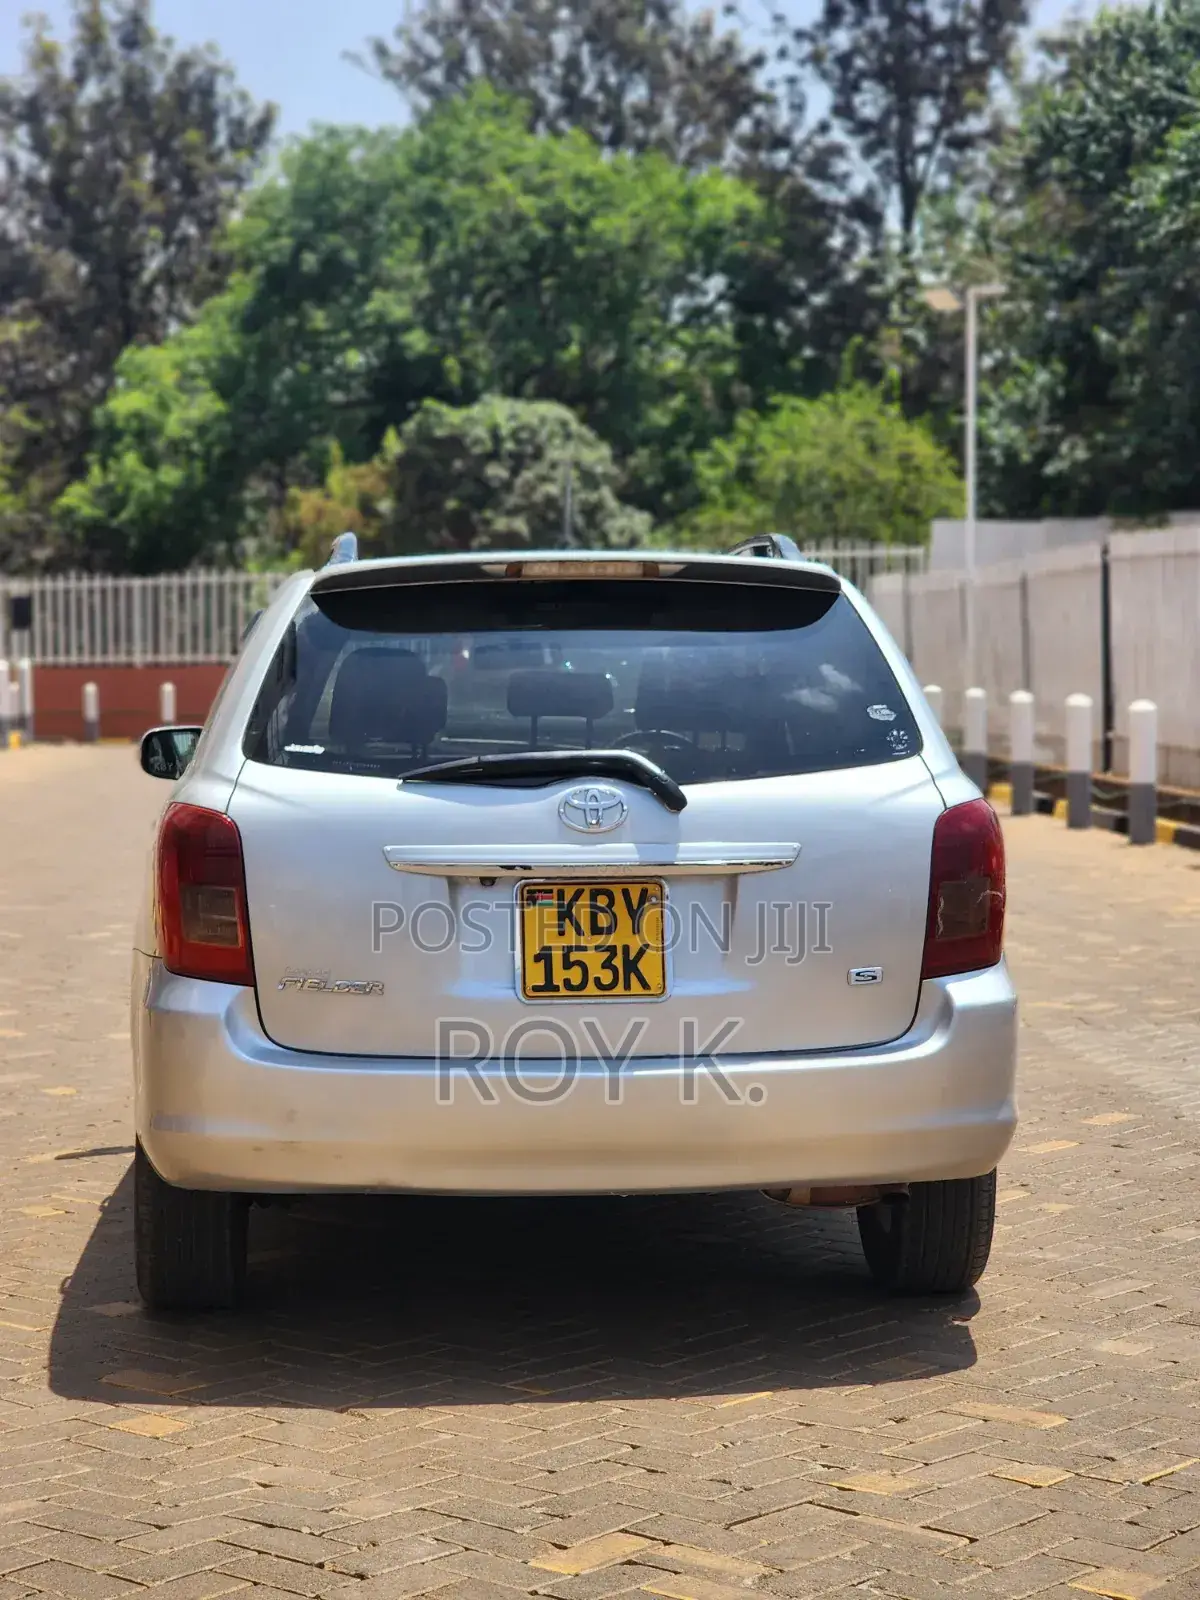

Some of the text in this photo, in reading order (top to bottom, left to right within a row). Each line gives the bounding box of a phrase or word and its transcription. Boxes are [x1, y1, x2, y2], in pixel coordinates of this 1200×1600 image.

[557, 888, 649, 936] KBY
[278, 976, 384, 996] FIELDER
[531, 943, 652, 992] 153K
